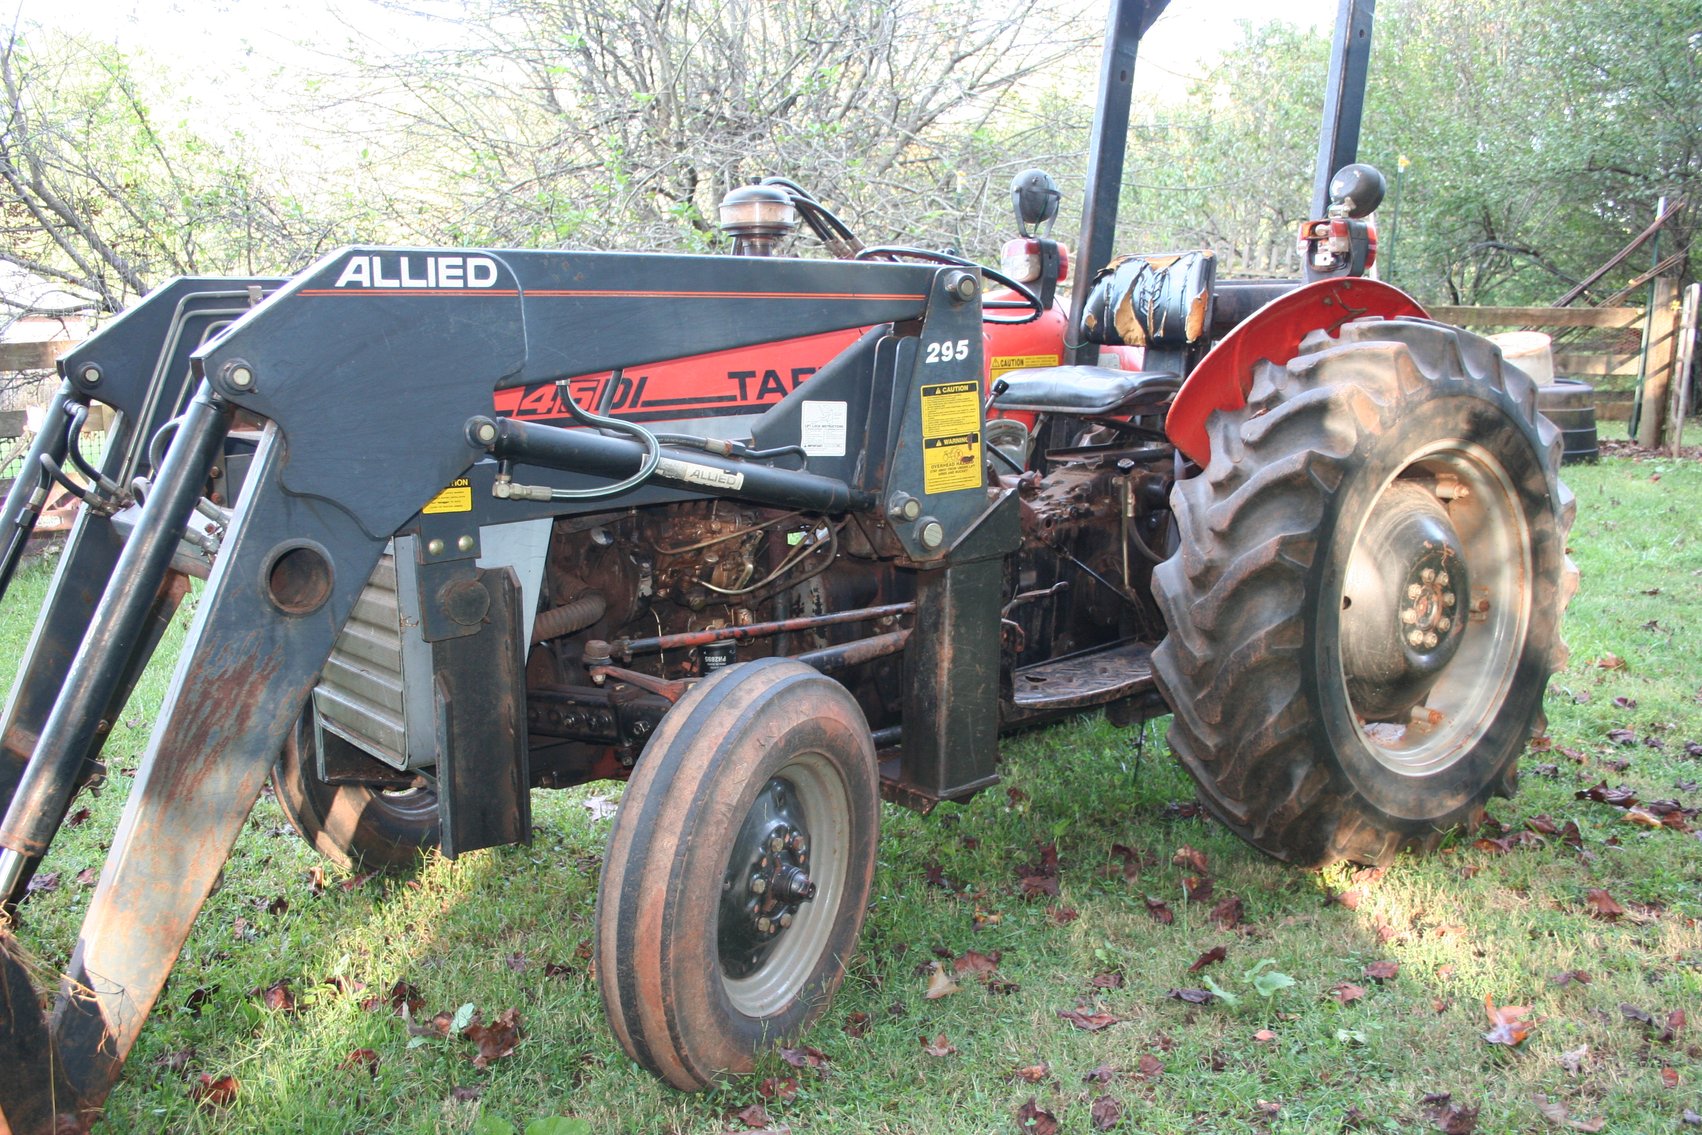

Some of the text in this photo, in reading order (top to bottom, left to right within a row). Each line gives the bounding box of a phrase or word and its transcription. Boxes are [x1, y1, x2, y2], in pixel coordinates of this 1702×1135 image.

[334, 256, 498, 288] ALLIED
[925, 340, 969, 364] 295
[1000, 358, 1024, 368] CAUTION
[727, 366, 822, 401] TAF
[942, 384, 969, 393] CAUTION
[689, 469, 737, 485] ALLIED
